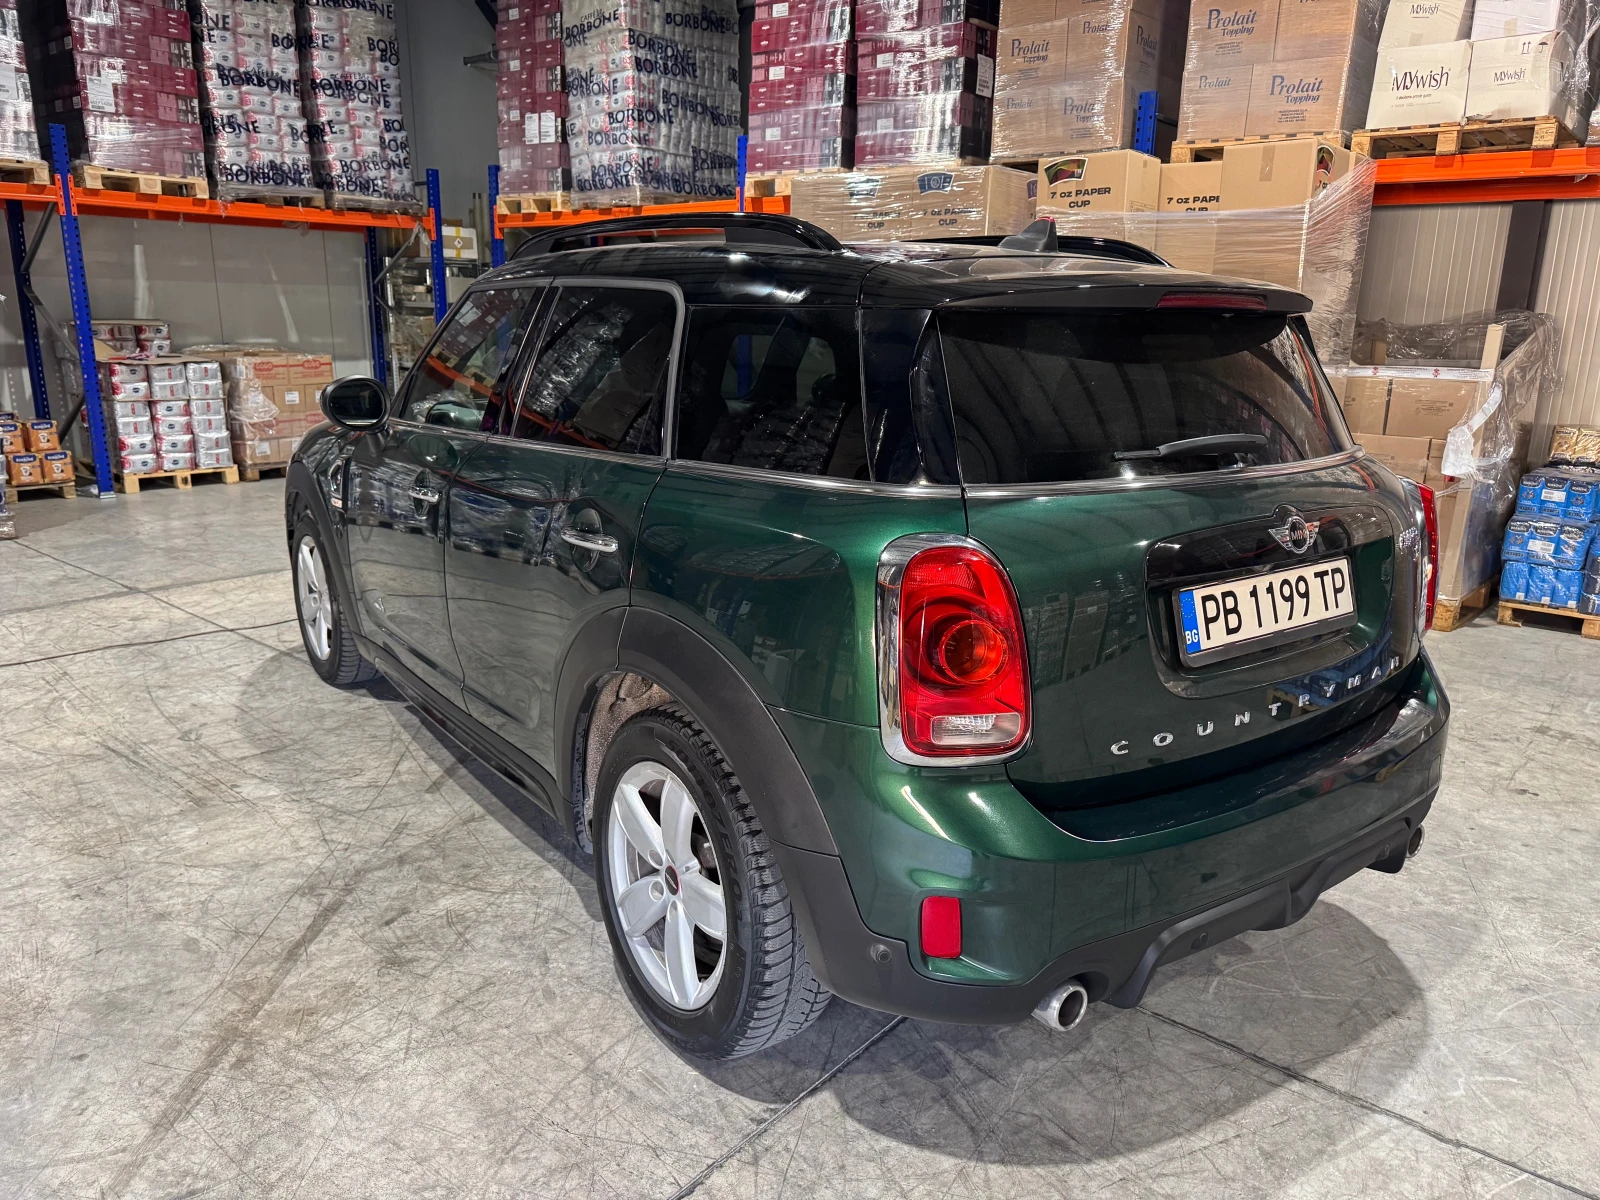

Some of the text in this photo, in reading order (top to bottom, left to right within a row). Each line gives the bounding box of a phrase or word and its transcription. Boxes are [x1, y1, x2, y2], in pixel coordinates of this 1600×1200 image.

[1207, 9, 1257, 30] Prolait
[1220, 27, 1255, 38] Topping
[1011, 39, 1051, 58] Prolait
[1022, 55, 1048, 65] Topping
[635, 56, 698, 79] BORBONE
[1199, 76, 1232, 90] Prolait
[1269, 75, 1324, 97] Prolait
[1285, 94, 1320, 107] Topping
[608, 108, 674, 125] BORBONE
[1075, 187, 1112, 198] PAPER
[1068, 200, 1091, 209] CUP
[1166, 197, 1174, 205] 7
[867, 222, 885, 230] CUP
[938, 218, 959, 227] CUP
[1201, 569, 1345, 640] PB 1199 TP
[1185, 629, 1199, 645] BG
[1109, 656, 1400, 756] COUNTRYMAN
